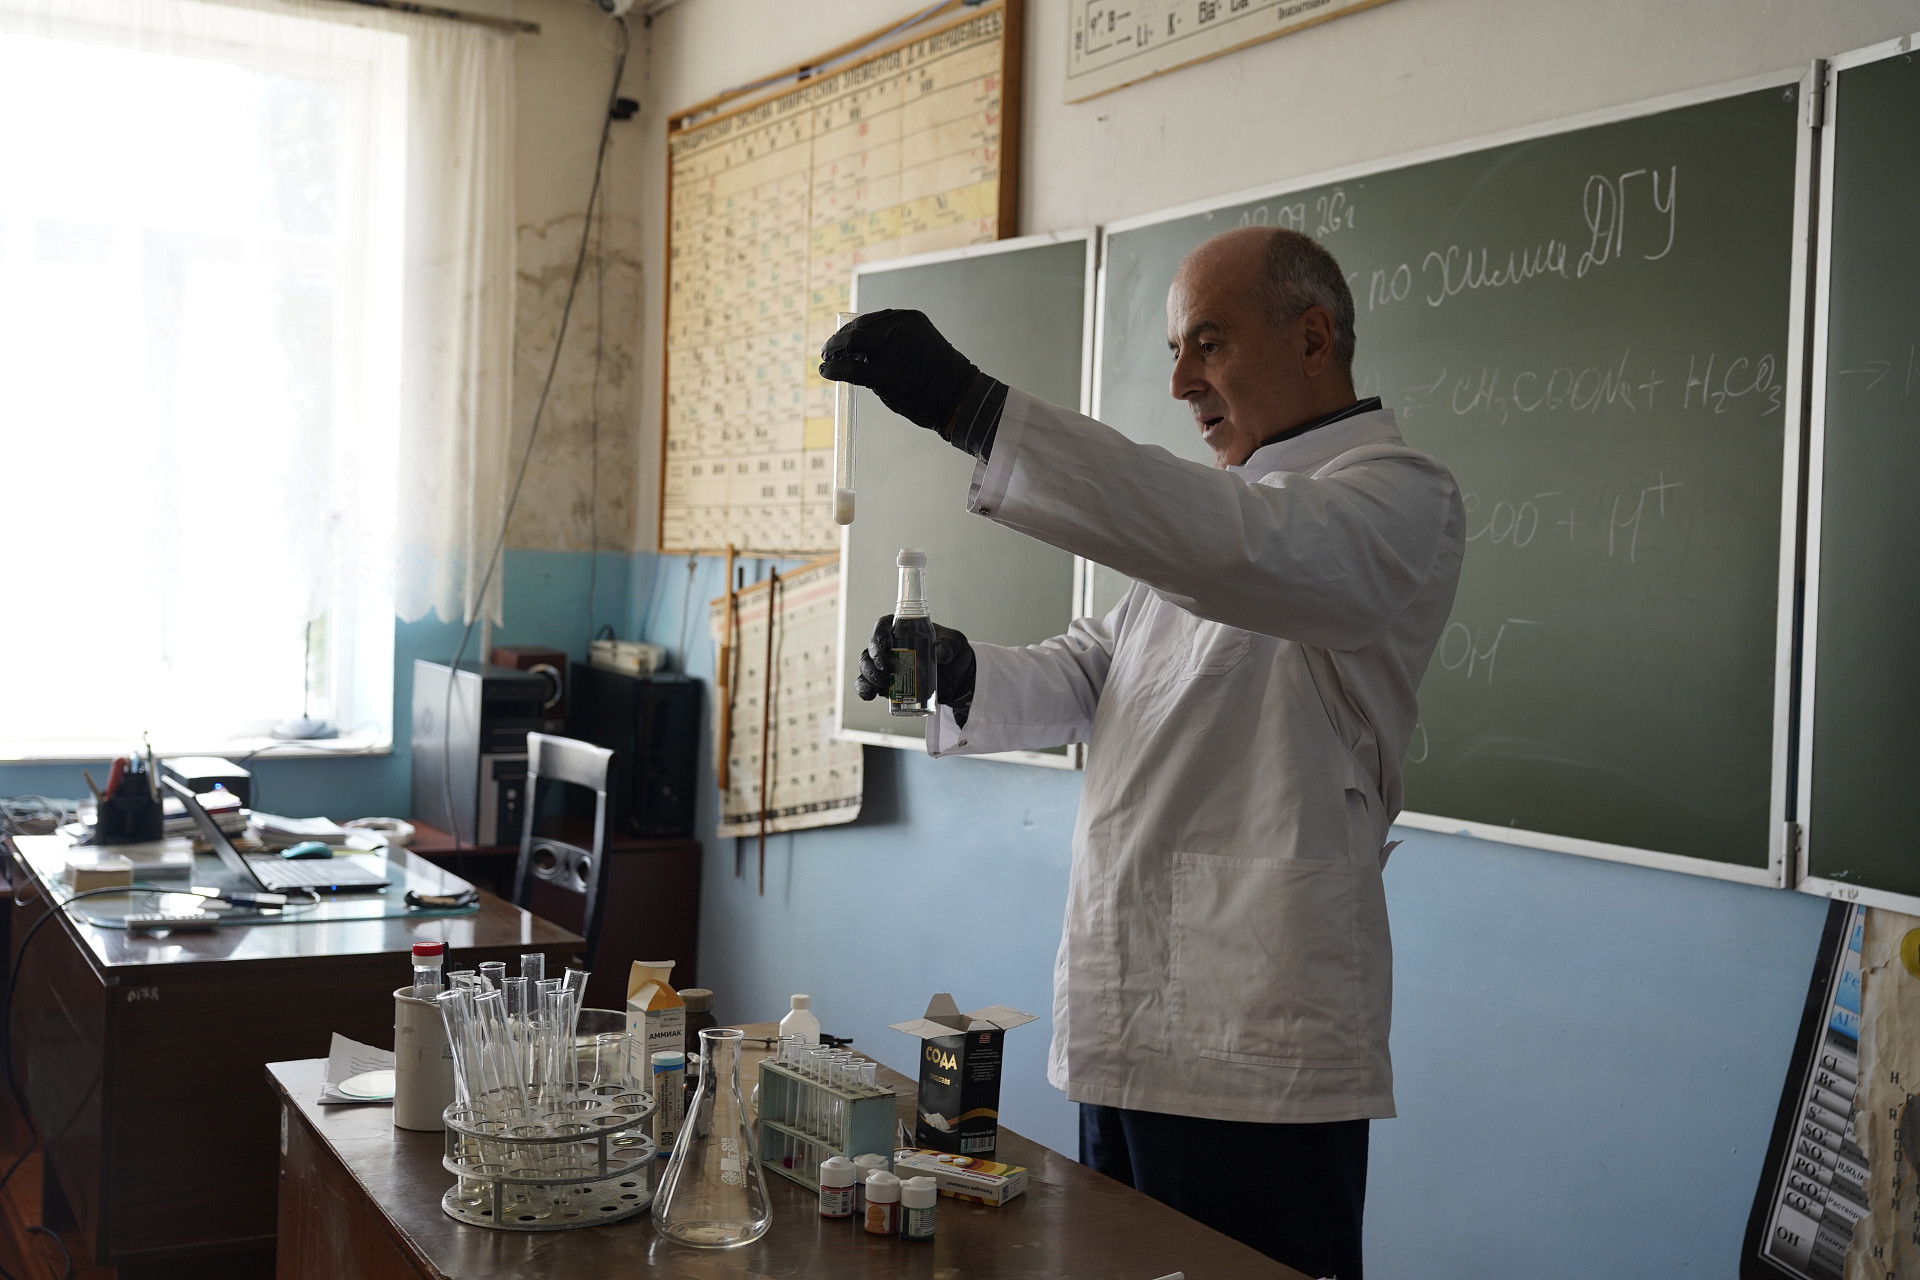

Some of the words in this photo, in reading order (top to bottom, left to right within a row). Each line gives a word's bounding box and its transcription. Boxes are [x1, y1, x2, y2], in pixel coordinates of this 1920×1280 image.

[1577, 165, 1677, 278] ДГУ
[649, 1029, 682, 1040] АММИАК
[925, 1045, 958, 1071] СОДА
